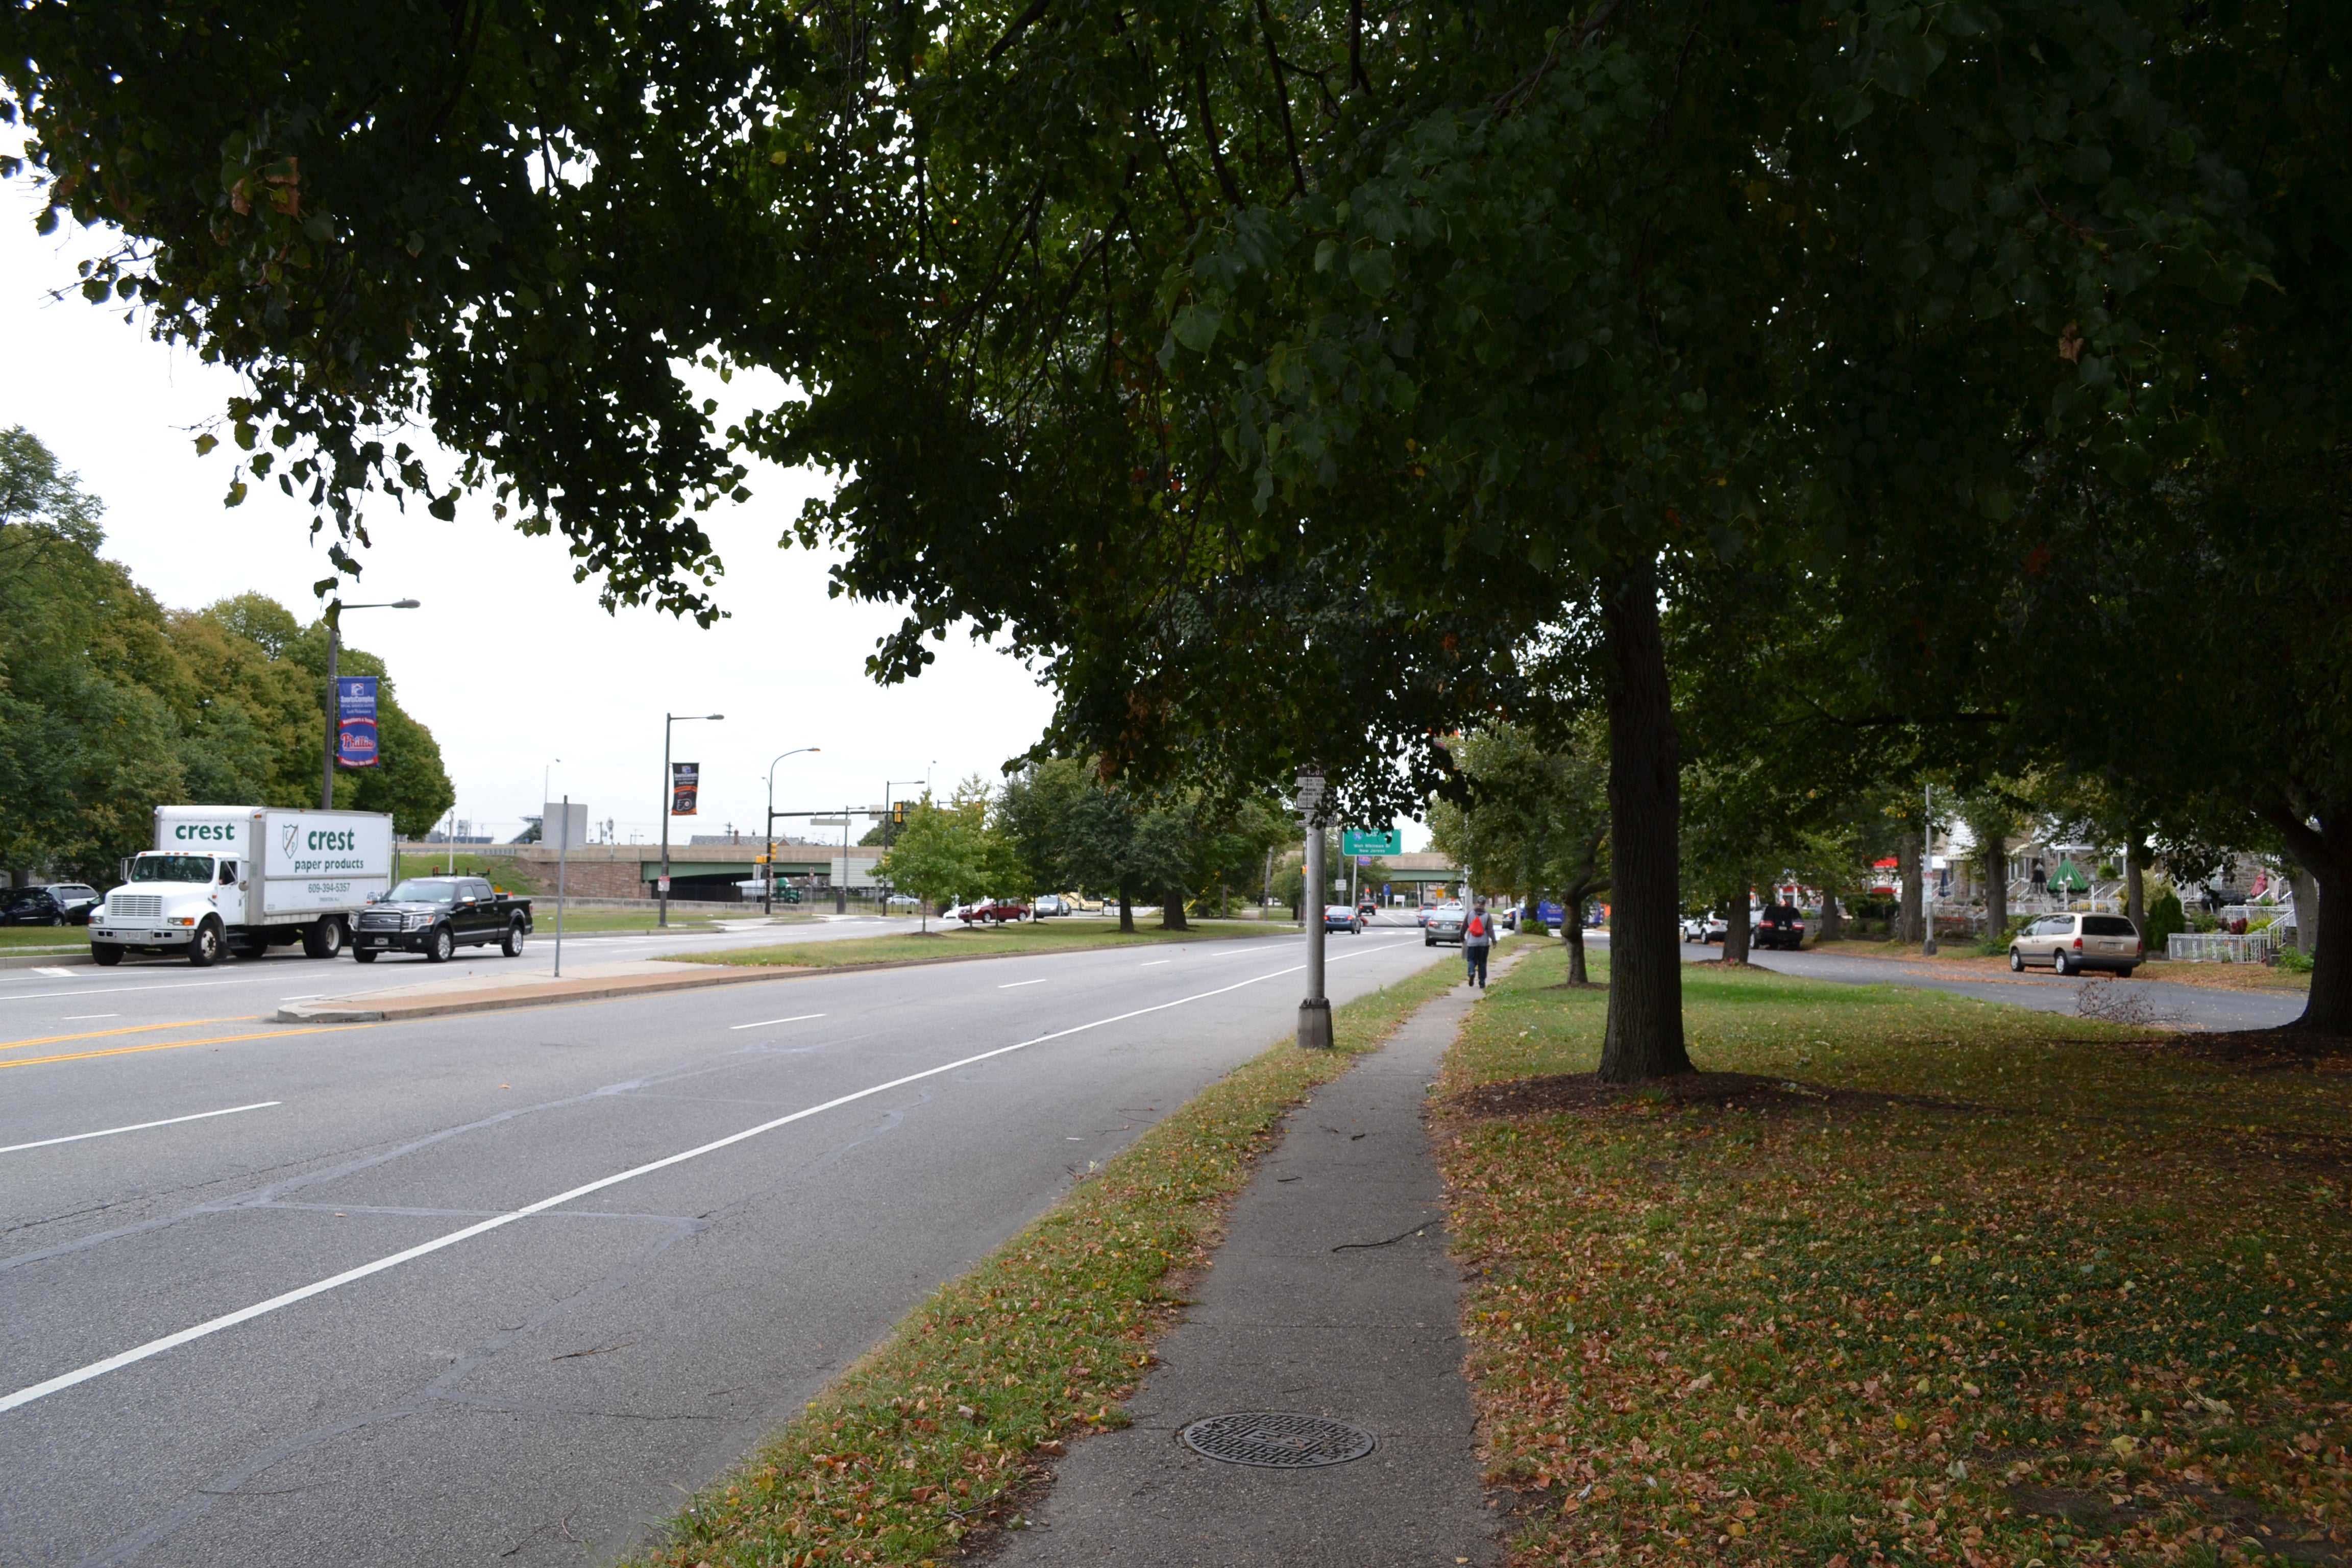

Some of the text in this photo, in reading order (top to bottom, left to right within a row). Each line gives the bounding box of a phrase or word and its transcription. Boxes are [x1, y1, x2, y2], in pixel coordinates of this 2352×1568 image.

[340, 732, 376, 752] Phillies
[176, 823, 235, 840] crest
[308, 827, 355, 851] crest
[295, 858, 364, 873] paper products
[308, 883, 351, 893] 609-394-5357
